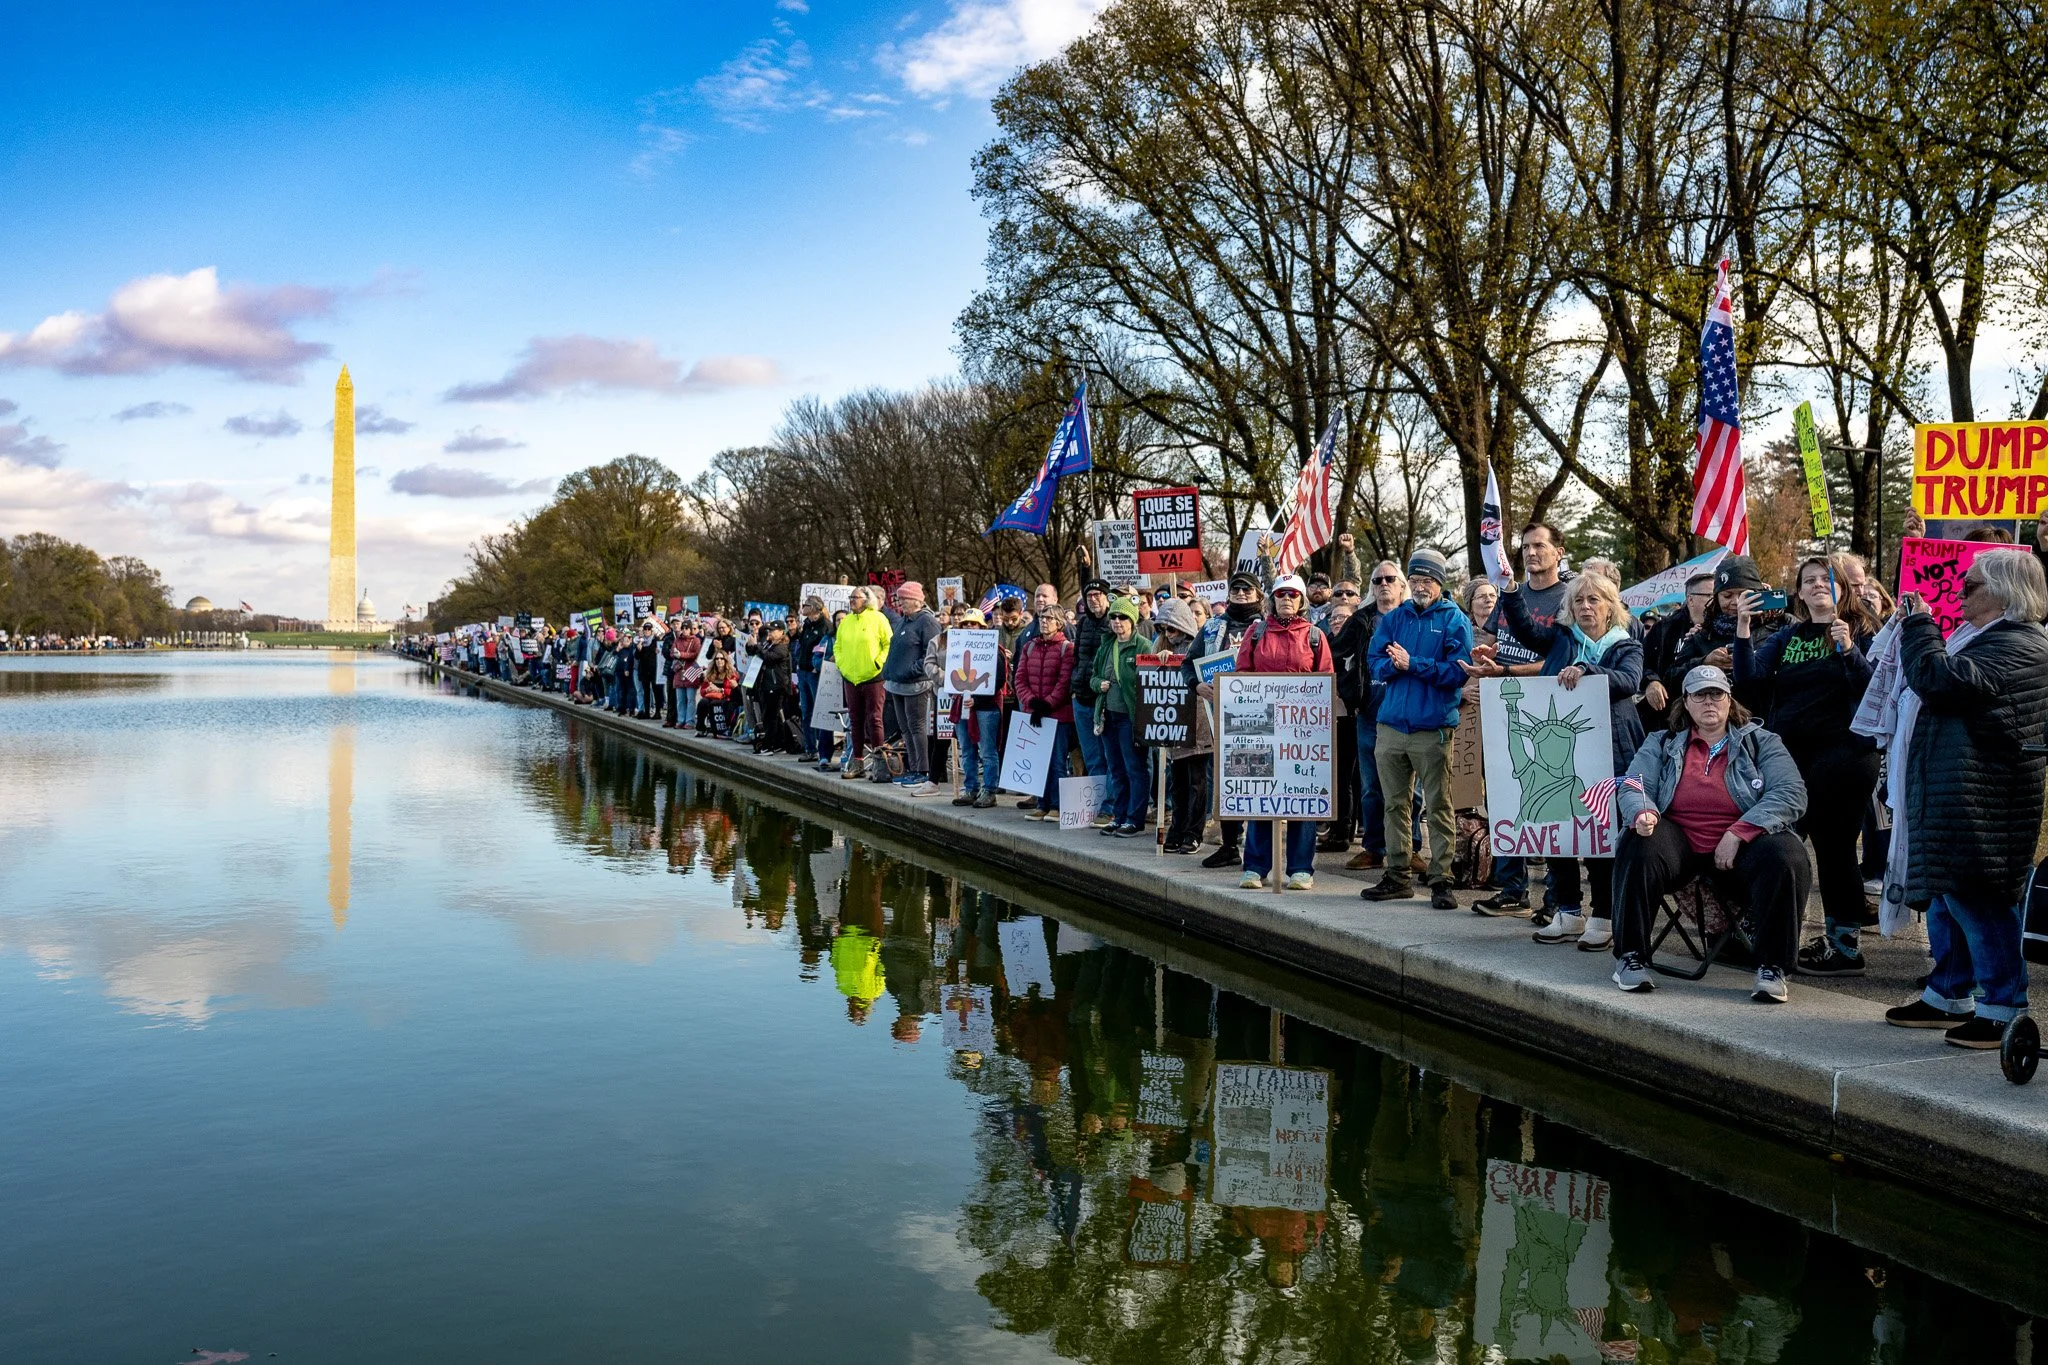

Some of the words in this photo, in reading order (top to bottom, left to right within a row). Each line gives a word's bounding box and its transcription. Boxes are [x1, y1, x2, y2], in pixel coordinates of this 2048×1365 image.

[1926, 426, 2048, 471] DUMP
[1175, 496, 1193, 511] SE
[1916, 475, 2048, 516] TRUMP
[1140, 513, 1195, 531] LARGUE
[1143, 530, 1193, 548] TRUMP
[1906, 541, 1966, 559] TRUMP
[1159, 553, 1183, 567] YA!
[1906, 556, 1916, 566] is
[1913, 559, 1960, 584] NOT
[965, 641, 996, 649] FASCISM
[973, 653, 994, 661] BIRD!
[1203, 662, 1233, 678] IMPEACH
[1139, 671, 1188, 687] TRUM
[1143, 688, 1188, 705] MUST
[1229, 679, 1261, 694] Quiet
[1264, 682, 1298, 699] piggies
[1300, 680, 1323, 694] don't
[1153, 706, 1177, 723] GO
[1278, 705, 1329, 726] TRASH
[1144, 724, 1188, 741] NOW!
[1294, 727, 1312, 738] the
[1463, 701, 1476, 776] MPEACH
[1279, 743, 1329, 762] HOUSE
[1225, 780, 1277, 795] SHITTY
[1284, 782, 1319, 794] tenants
[1225, 796, 1253, 812] GET
[1260, 797, 1329, 815] EVICTED
[1494, 819, 1561, 855] SAVE
[1572, 815, 1612, 855] ME
